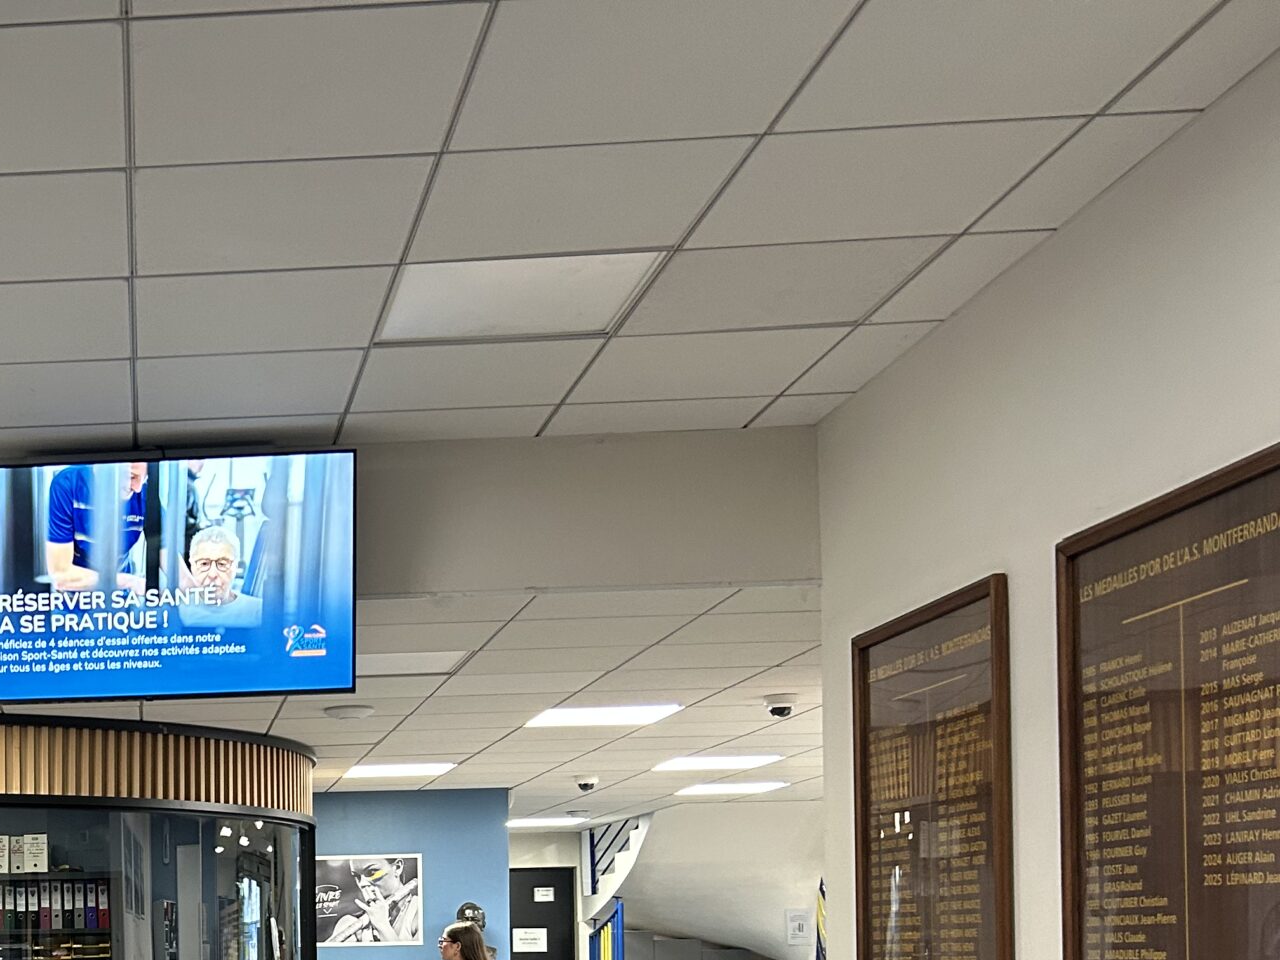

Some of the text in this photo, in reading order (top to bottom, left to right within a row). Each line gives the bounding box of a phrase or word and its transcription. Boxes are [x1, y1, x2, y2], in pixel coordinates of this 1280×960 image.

[1080, 511, 1280, 603] LES MEDAILLES D'OR DE L'A.S. MONTFERRAND
[111, 590, 141, 608] SA
[145, 584, 222, 607] SANTÉ,
[20, 614, 46, 633] SE
[51, 611, 158, 634] PRATIQUE
[163, 610, 168, 628] !
[1200, 628, 1217, 644] 2013
[1259, 609, 1280, 626] Jacqu
[35, 638, 47, 648] de
[49, 638, 56, 648] 4
[57, 637, 95, 647] séances
[97, 636, 129, 646] d'essai
[131, 635, 169, 646] offertes
[170, 634, 194, 644] dans
[196, 633, 221, 642] notre
[1200, 628, 1280, 663] 2014 MARIE-CATHERI
[22, 648, 78, 662] Sport-Santé
[80, 649, 90, 659] et
[92, 646, 139, 659] découvrez
[142, 648, 159, 656] nos
[161, 644, 200, 656] activités
[202, 643, 246, 656] adaptées
[1223, 653, 1258, 672] Françoise
[10, 663, 30, 672] tous
[32, 662, 46, 672] les
[48, 661, 71, 674] âges
[73, 661, 82, 671] et
[84, 660, 105, 670] tous
[107, 660, 121, 669] les
[123, 659, 162, 669] niveaux.
[1200, 671, 1265, 696] 2015 MAS Serge
[1200, 701, 1219, 715] 2016
[1224, 686, 1275, 710] SAUVAGNAT
[1200, 718, 1219, 734] 2017
[1224, 710, 1261, 729] MIGNARD
[1201, 727, 1280, 751] 2018 GUITTARD Lion
[1200, 748, 1275, 771] 2019 MOREL Pierre
[1202, 767, 1280, 789] 2020 VIALIS Christel
[1085, 783, 1098, 795] 1992
[1202, 785, 1280, 808] 2021 CHALMIN Adri
[1203, 807, 1277, 826] 2022 UHL Sandrine
[1203, 828, 1280, 846] 2023 LANIRAY Henr
[1134, 845, 1147, 858] Guy
[1203, 851, 1276, 867] 2024 AUGER Alain
[1204, 873, 1223, 886] 2025
[1226, 870, 1265, 886] LÉPINARD
[1139, 895, 1168, 907] Christian
[1140, 913, 1177, 925] Jean-Pierre
